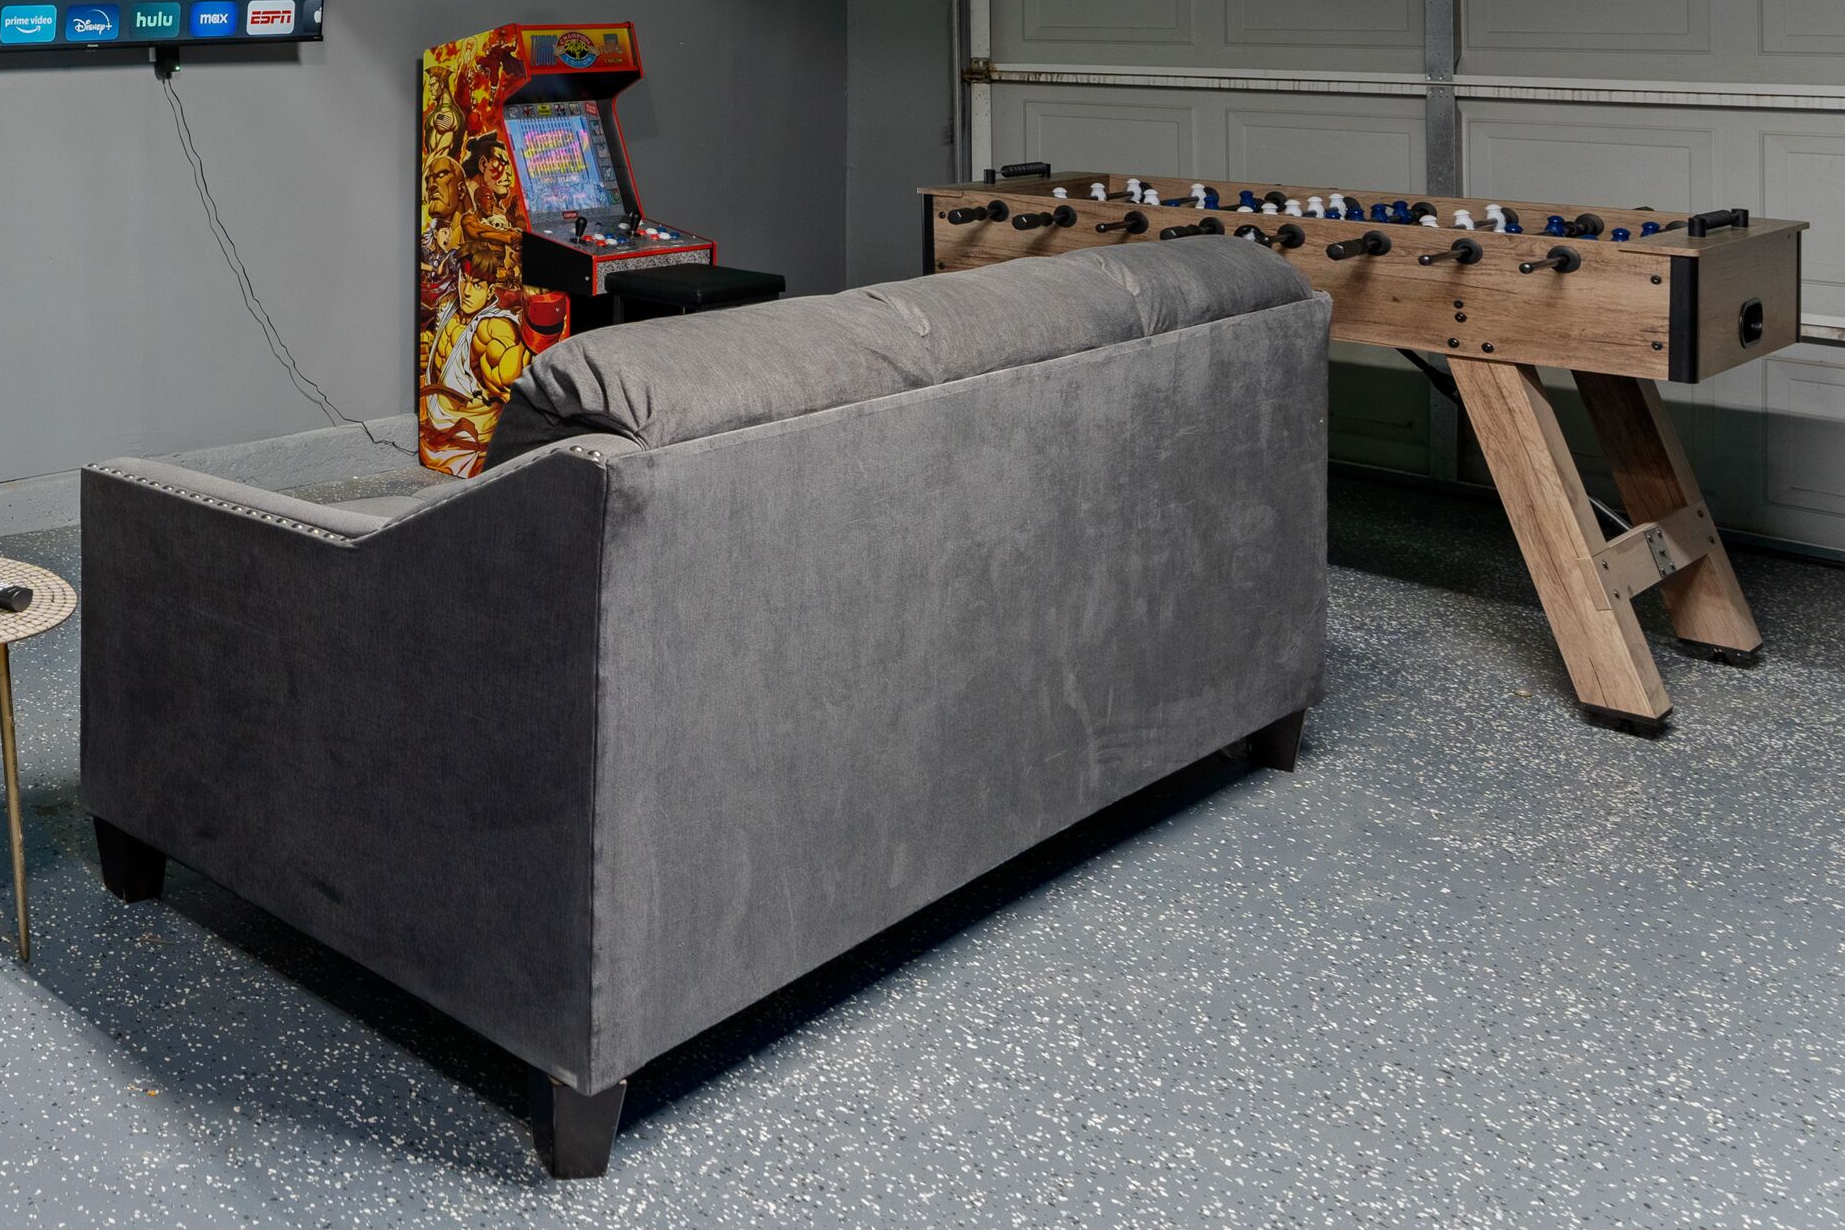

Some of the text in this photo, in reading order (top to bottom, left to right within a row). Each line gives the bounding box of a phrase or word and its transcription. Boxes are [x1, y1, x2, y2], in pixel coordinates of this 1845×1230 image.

[5, 16, 52, 28] prime video
[136, 11, 172, 28] hulu
[200, 12, 228, 24] max
[250, 10, 292, 25] ESPN
[73, 18, 112, 35] Disney+
[560, 32, 590, 46] CHAMPION
